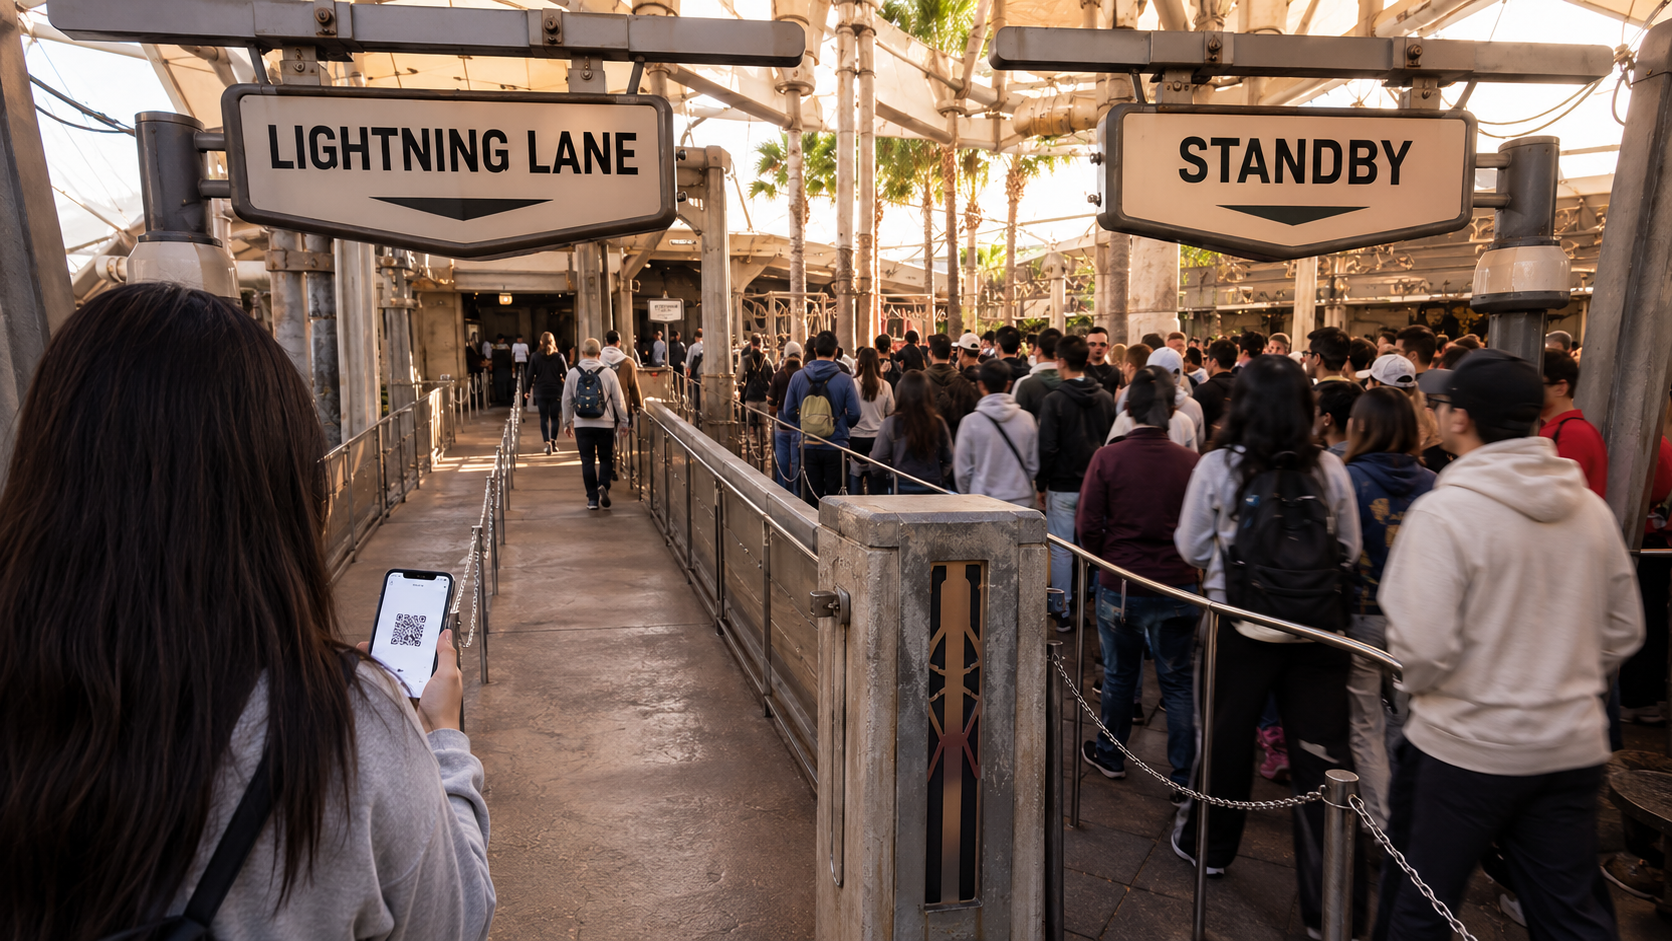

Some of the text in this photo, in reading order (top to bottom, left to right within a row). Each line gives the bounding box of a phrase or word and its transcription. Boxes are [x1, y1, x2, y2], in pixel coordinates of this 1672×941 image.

[268, 125, 639, 176] LIGHTNING LANE
[1178, 136, 1414, 186] STANDBY
